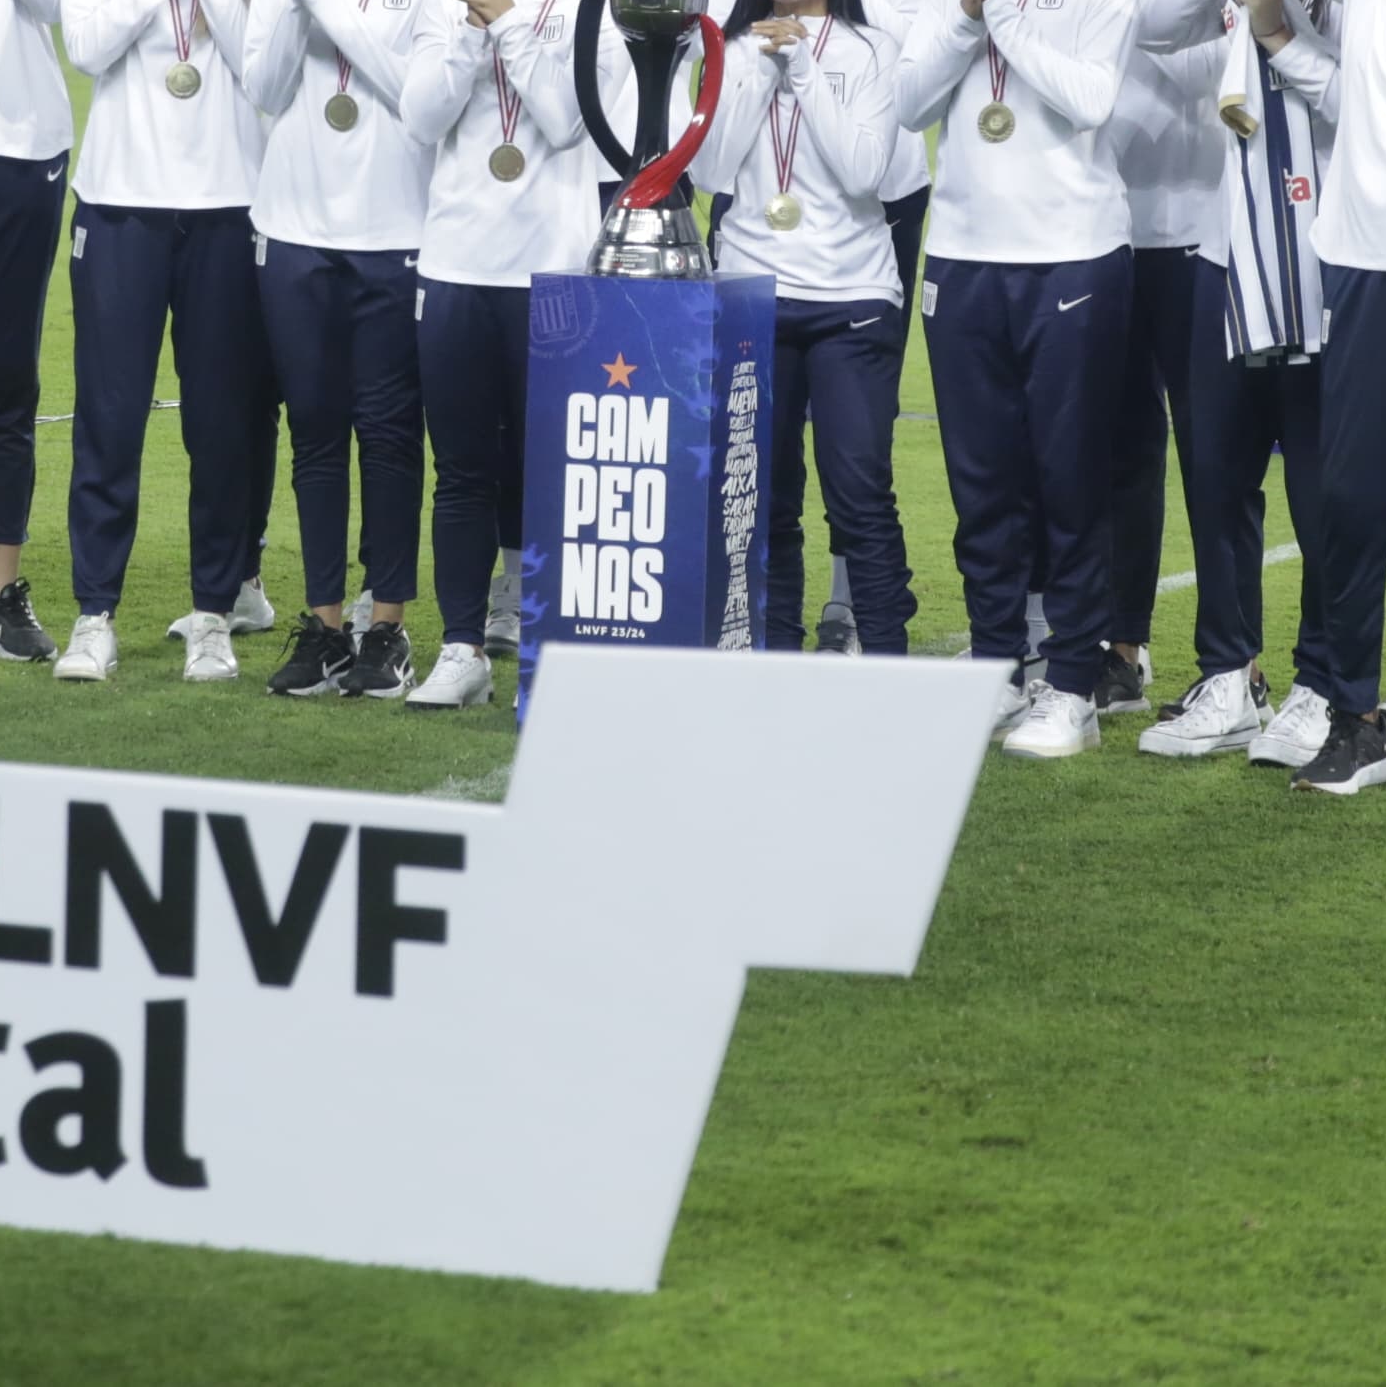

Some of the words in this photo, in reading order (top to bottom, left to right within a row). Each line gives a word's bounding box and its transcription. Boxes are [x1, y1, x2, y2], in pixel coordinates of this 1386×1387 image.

[566, 392, 669, 464] CAM
[563, 463, 666, 544] PEO
[721, 470, 756, 496] AIXA
[723, 490, 758, 517] SARAH
[560, 543, 664, 622] NAS
[575, 624, 608, 637] LNVF
[611, 626, 646, 639] 23/24
